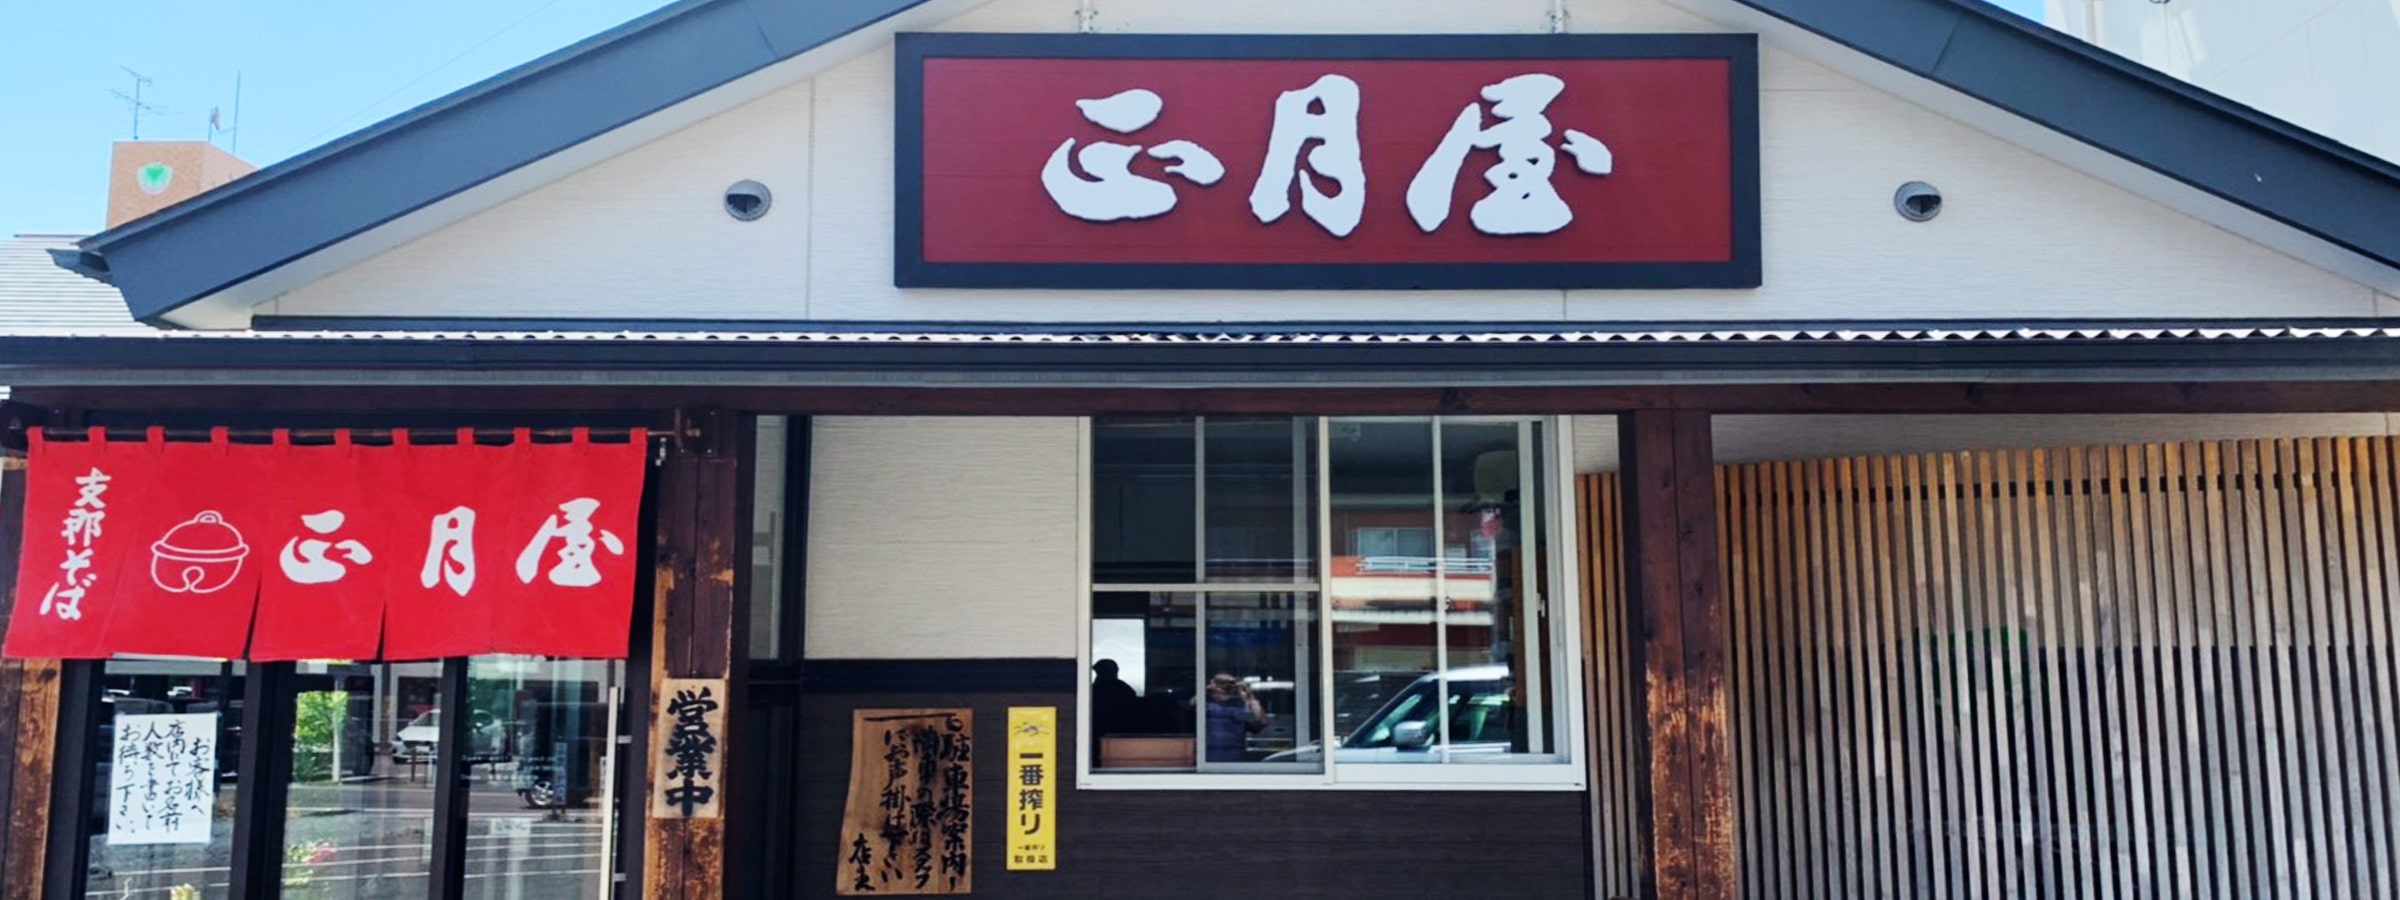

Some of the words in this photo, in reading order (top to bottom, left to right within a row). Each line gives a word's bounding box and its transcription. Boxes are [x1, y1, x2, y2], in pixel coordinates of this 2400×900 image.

[1041, 73, 1613, 236] 正月屋
[39, 467, 111, 620] 支那そば
[279, 497, 624, 596] 正月屋
[158, 719, 186, 833] 店内にてお名前
[184, 737, 211, 815] お客様へ
[665, 686, 718, 817] 営業中
[1019, 752, 1044, 835] 一番搾り
